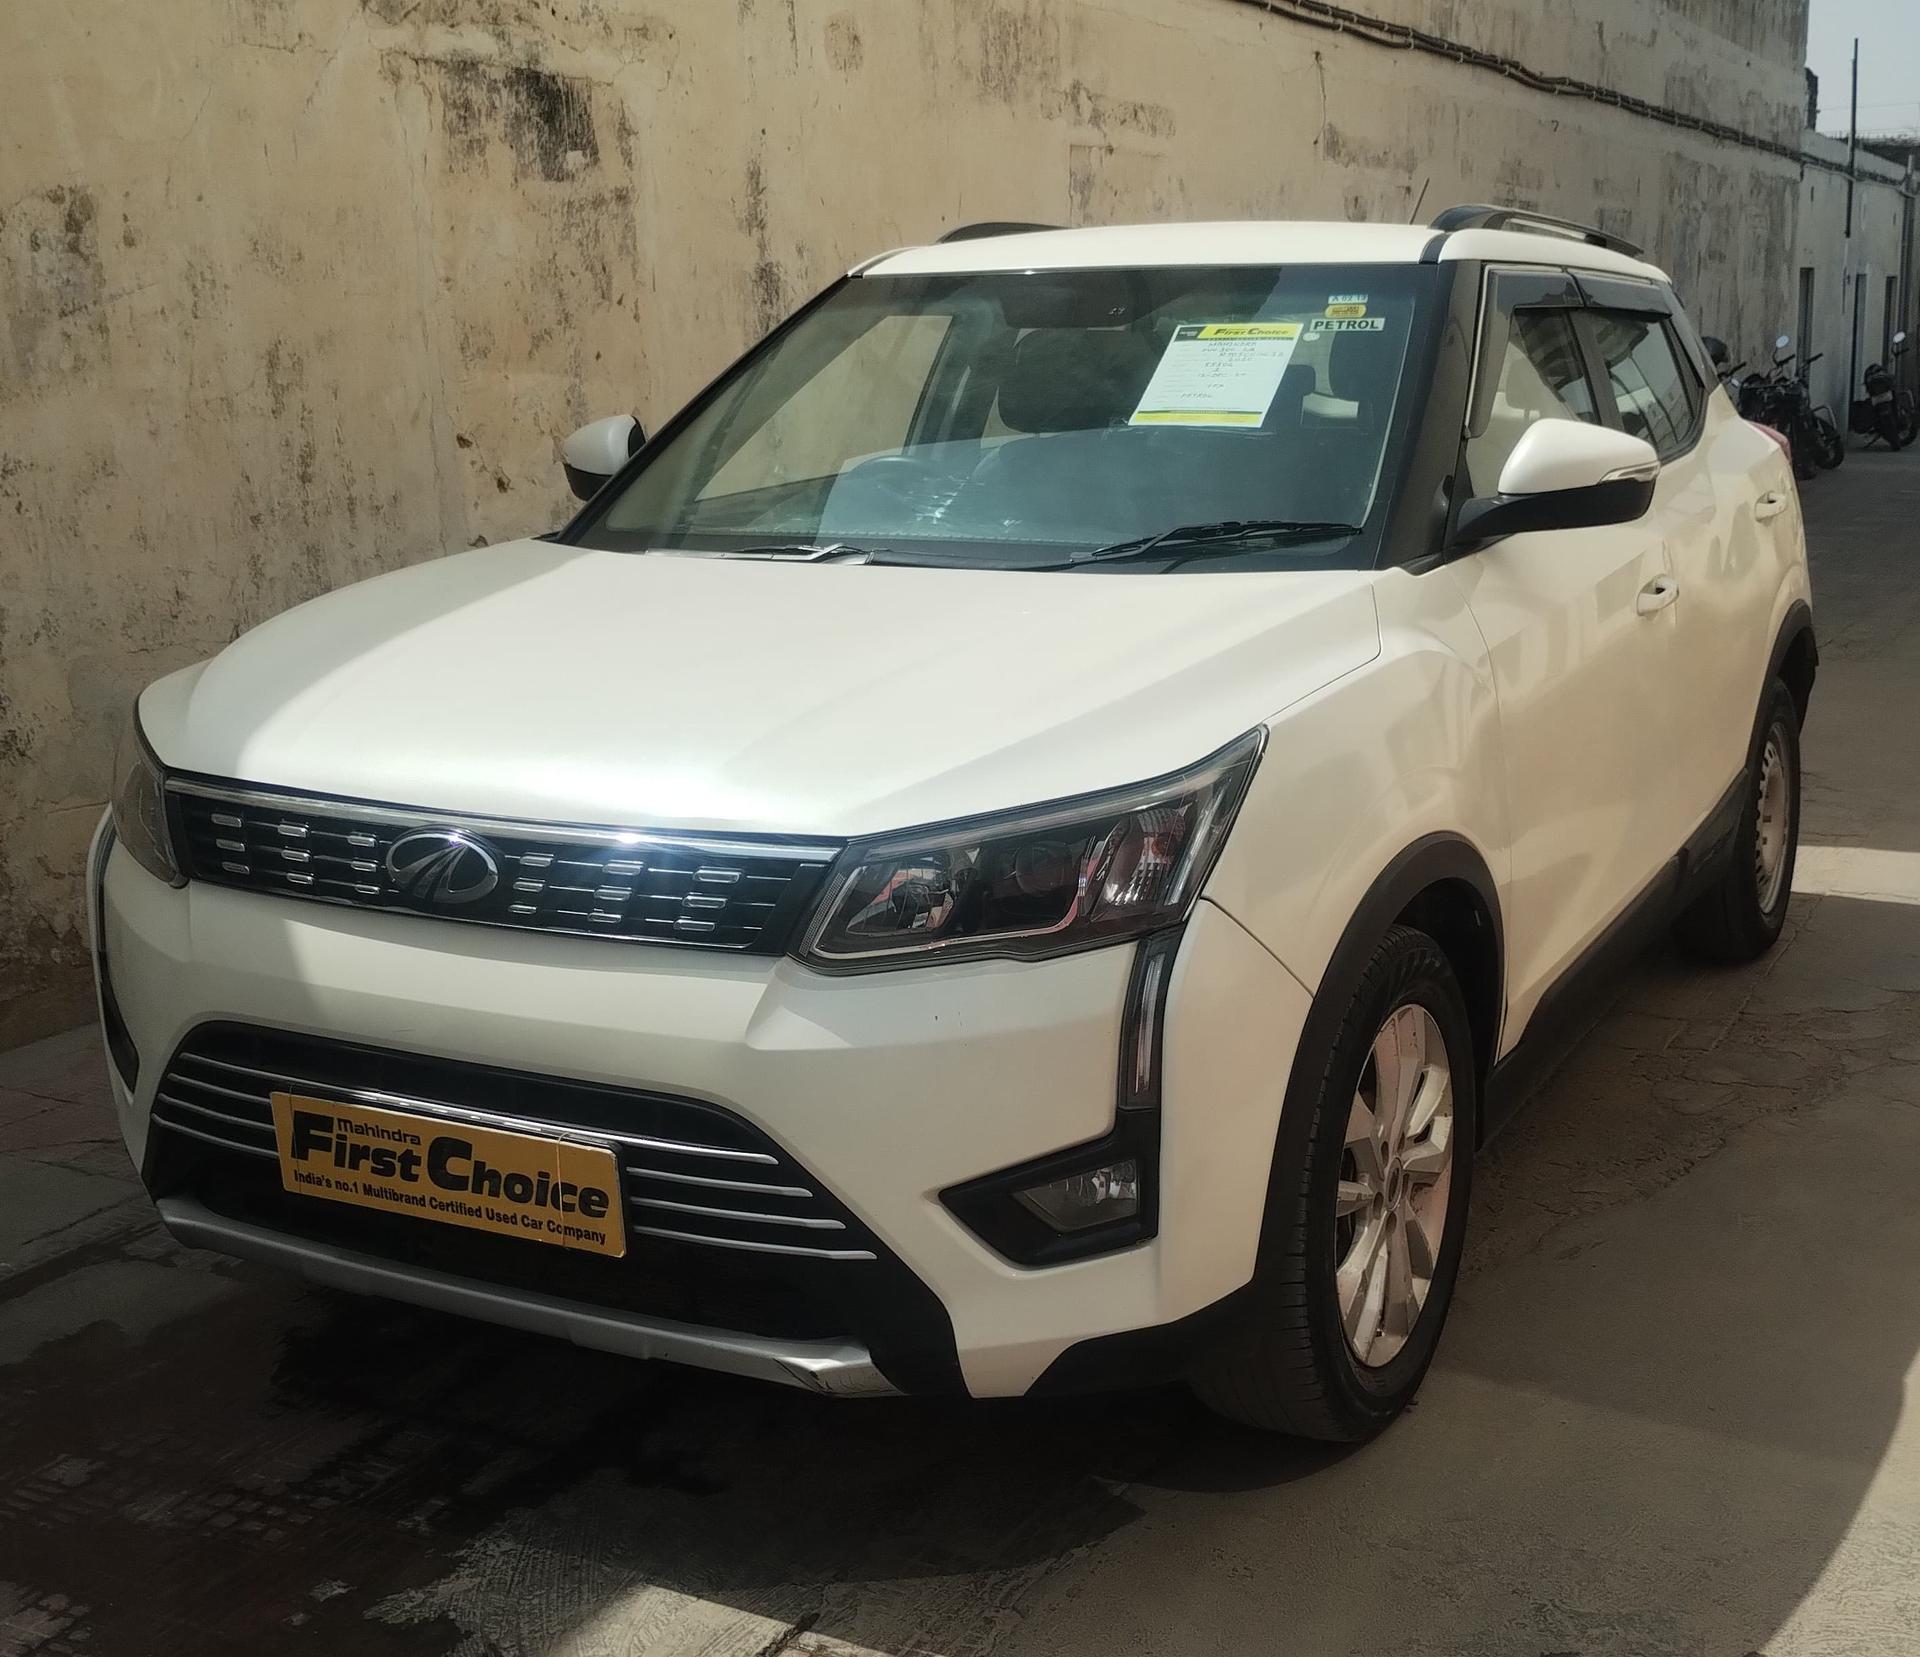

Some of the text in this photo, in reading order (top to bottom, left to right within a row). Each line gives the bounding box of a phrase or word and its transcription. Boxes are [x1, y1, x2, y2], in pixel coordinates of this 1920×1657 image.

[1213, 327, 1289, 336] First Choice
[1313, 319, 1379, 330] PETROL
[290, 1109, 610, 1218] First Choice
[294, 1169, 607, 1246] India's no.1 Multibrand Certified Used Car Company
